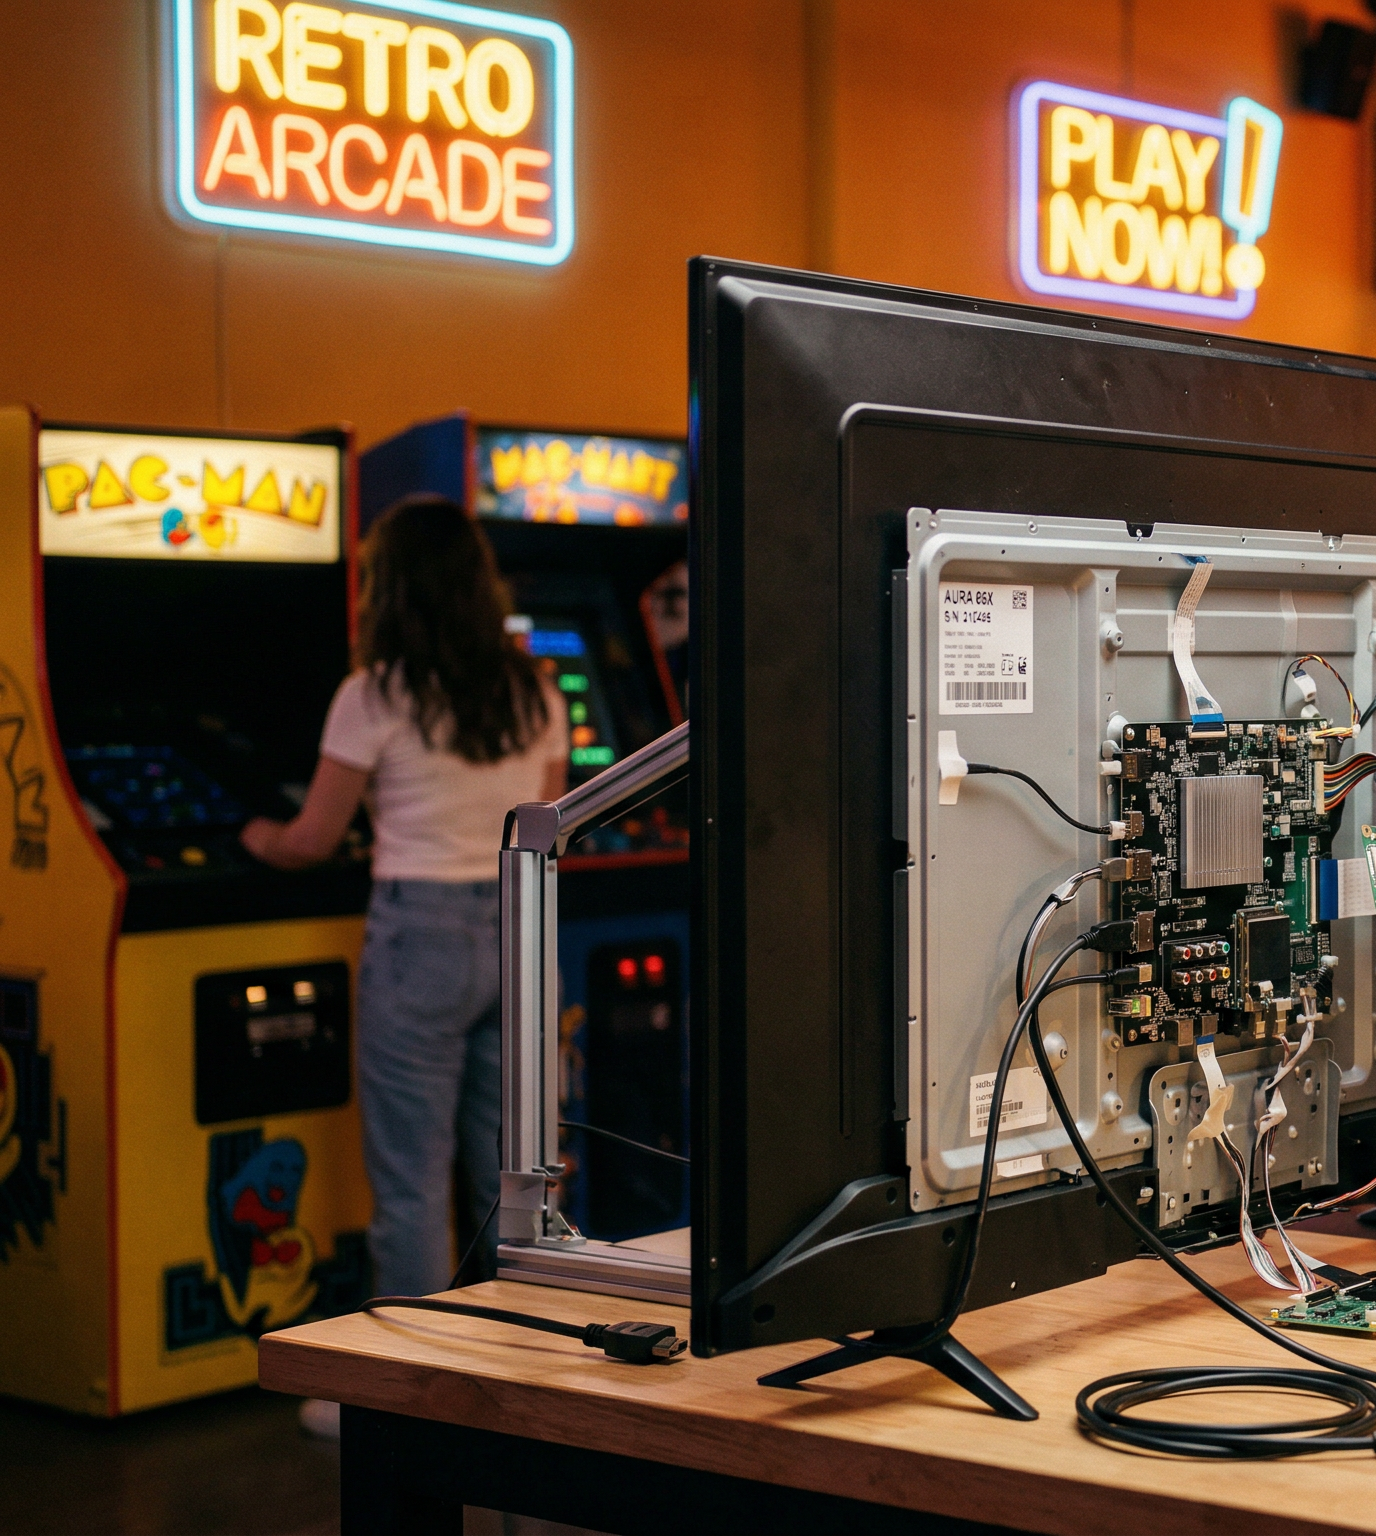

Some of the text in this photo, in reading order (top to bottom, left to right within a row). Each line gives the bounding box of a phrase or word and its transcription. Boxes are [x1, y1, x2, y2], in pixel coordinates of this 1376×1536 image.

[214, 0, 534, 137] RETRO
[204, 105, 552, 236] ARCADE
[1051, 105, 1220, 214] PLAY
[44, 455, 328, 531] PAC-MAN
[944, 589, 973, 605] AURA
